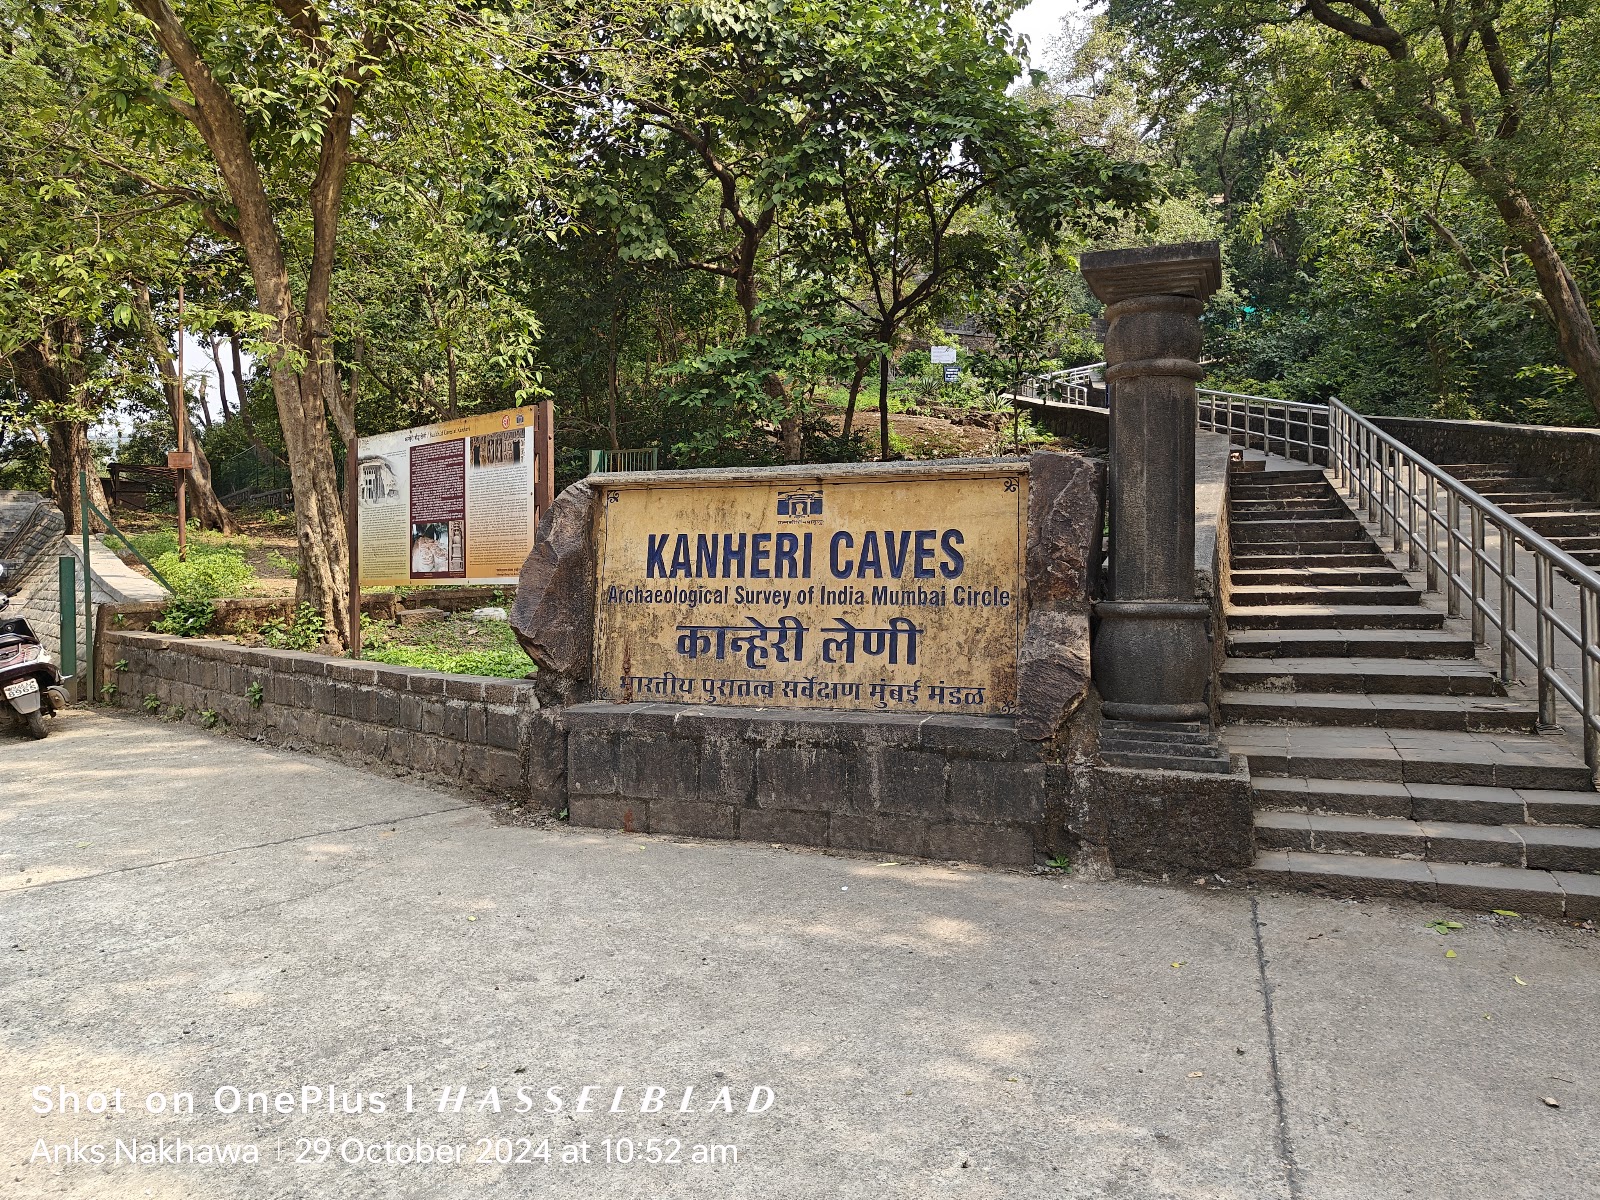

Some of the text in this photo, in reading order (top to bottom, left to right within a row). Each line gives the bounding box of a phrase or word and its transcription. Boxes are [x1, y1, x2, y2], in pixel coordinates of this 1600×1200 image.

[646, 529, 965, 579] KANHERI CAVES
[607, 585, 1011, 610] Archaeological Survey of India Mumbai Circle
[676, 616, 924, 669] कान्हेरी लेणी
[619, 671, 987, 709] भारतीय पुरातत्व सर्वेक्षण मुंबई मंडळ
